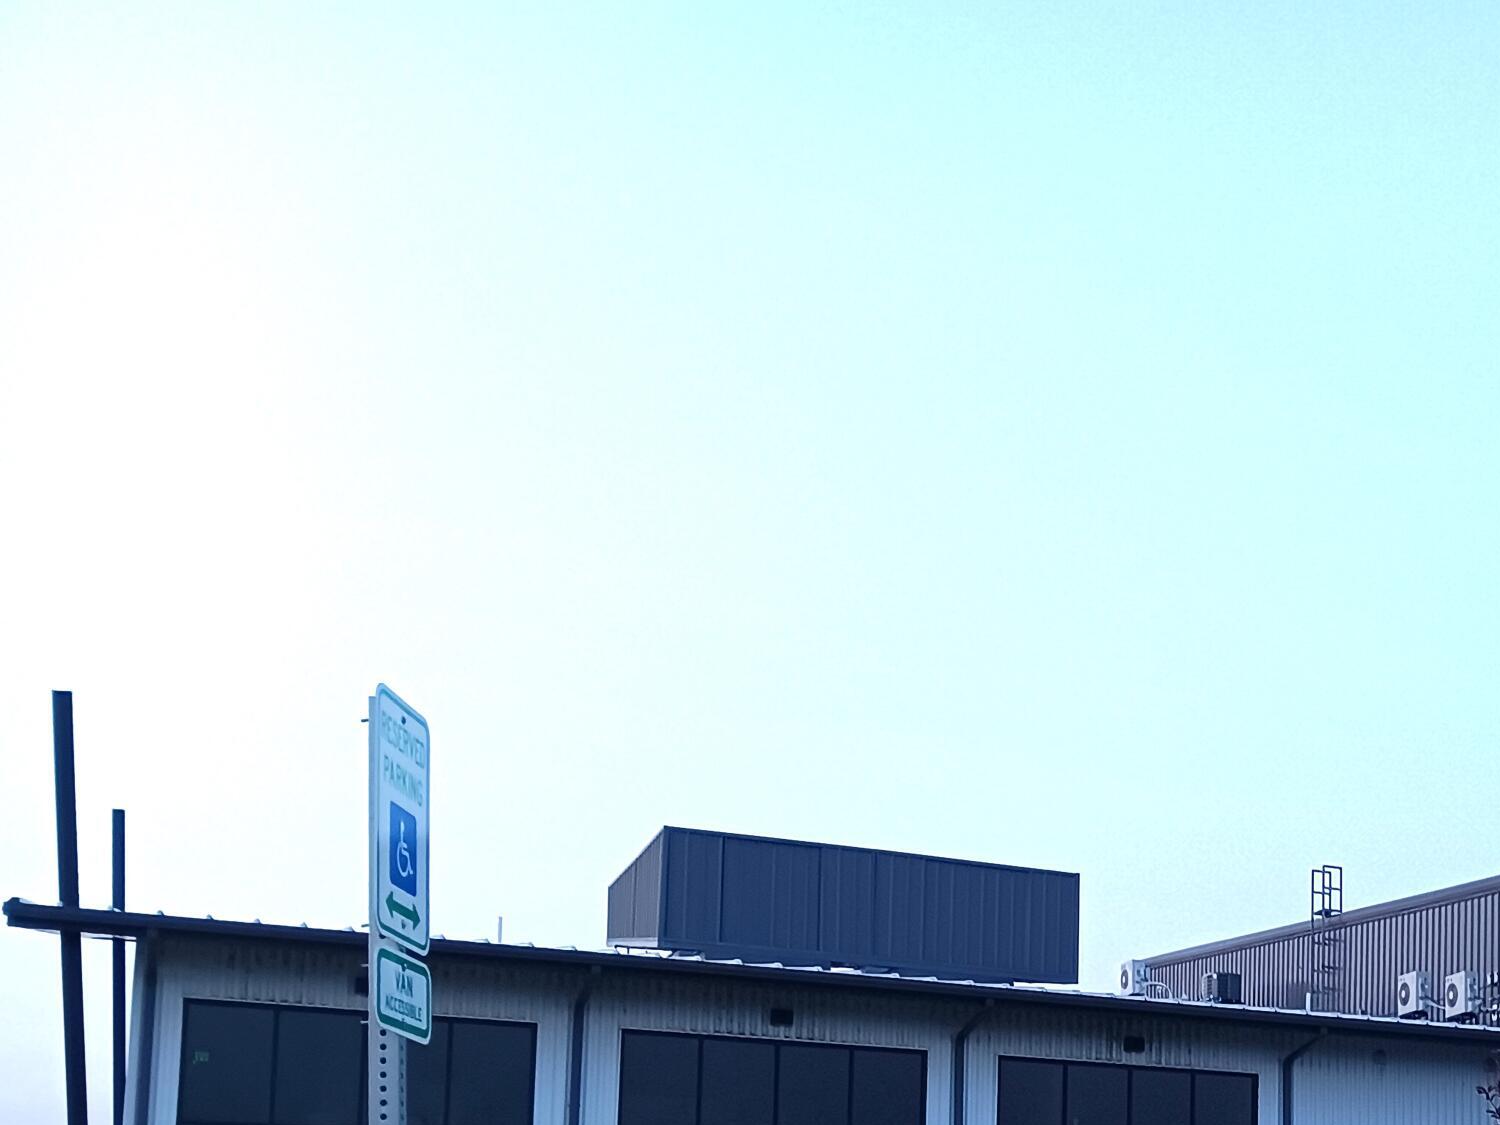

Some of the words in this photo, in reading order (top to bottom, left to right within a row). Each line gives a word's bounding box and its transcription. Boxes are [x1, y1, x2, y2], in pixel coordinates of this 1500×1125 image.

[382, 710, 424, 769] RESERVED
[384, 754, 423, 807] PARKING
[394, 970, 413, 998] VAN
[385, 994, 422, 1022] ACCESSIBLE
